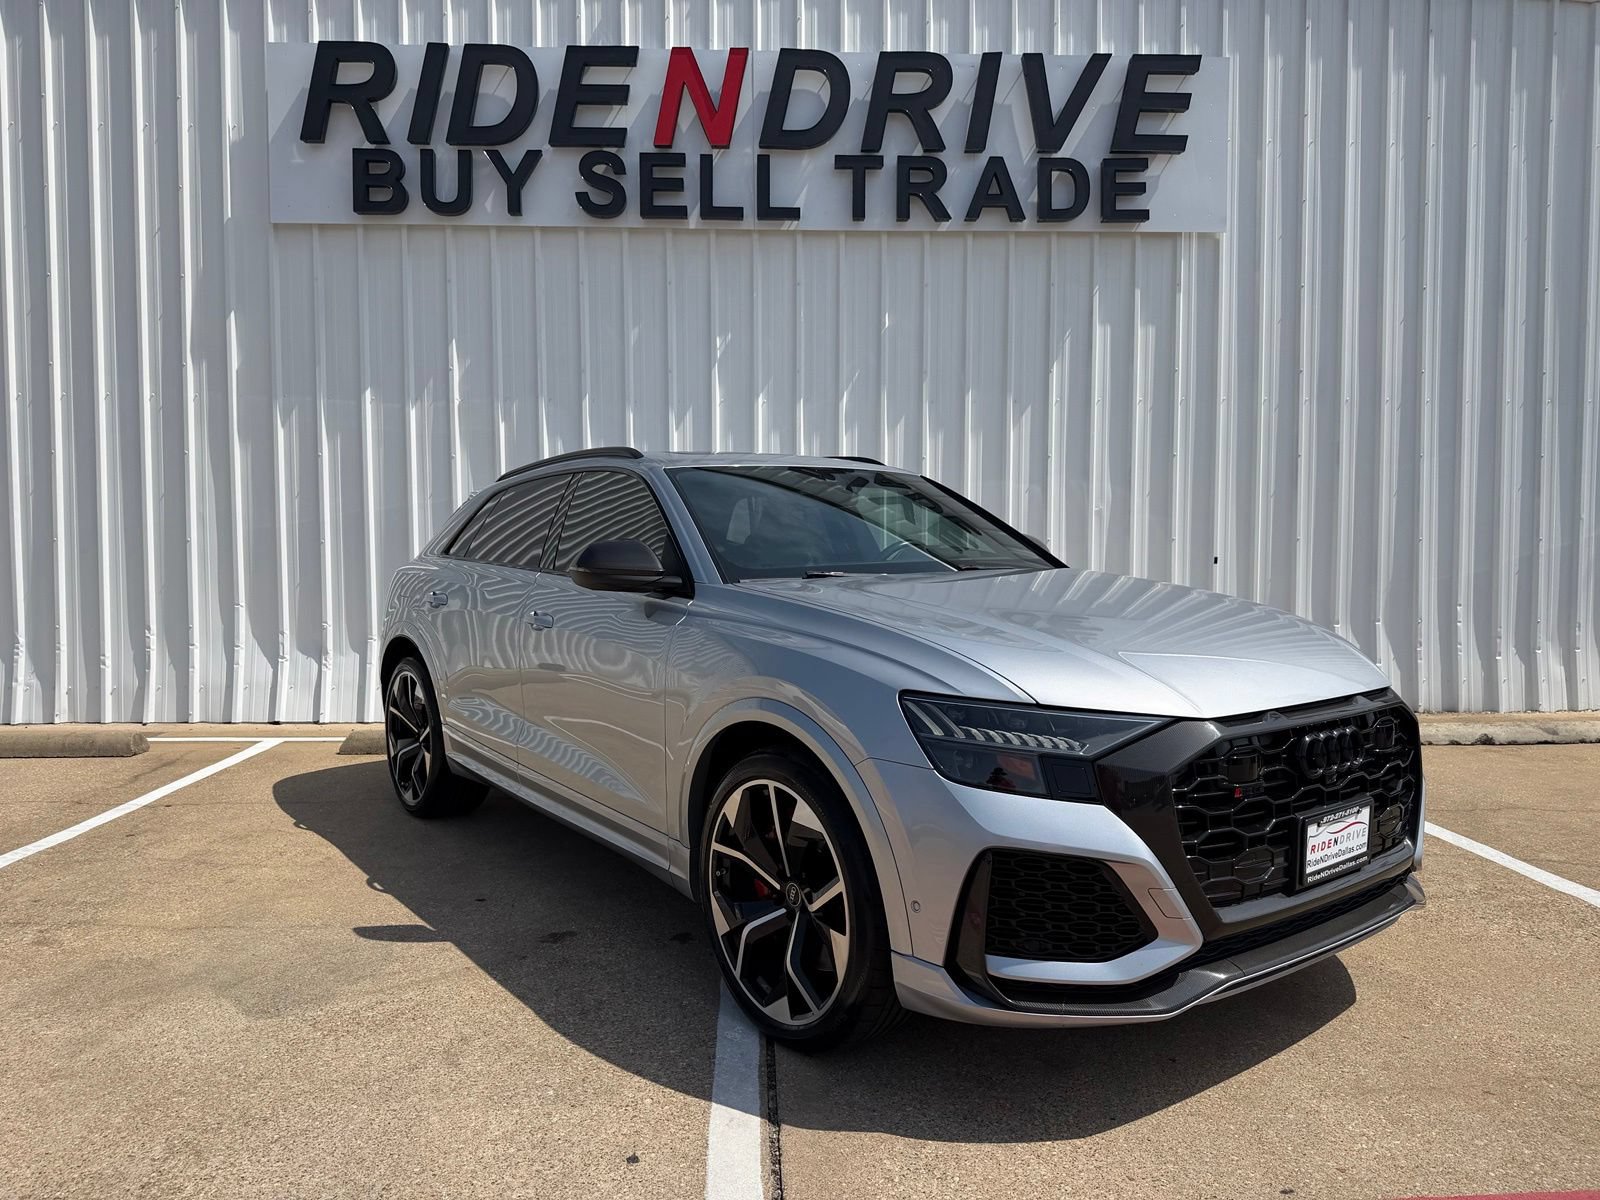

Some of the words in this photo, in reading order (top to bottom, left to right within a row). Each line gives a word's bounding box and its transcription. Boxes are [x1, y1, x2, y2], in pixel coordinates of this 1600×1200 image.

[300, 41, 1202, 154] RIDENDRIVE
[352, 148, 543, 216] BUY
[575, 150, 801, 221] SELL
[834, 155, 1150, 223] TRADE
[1310, 827, 1367, 855] RIDENDRIVE
[1306, 842, 1367, 869] RideNDriveDallas.com
[1307, 856, 1368, 883] RideNDriveDallas.com
